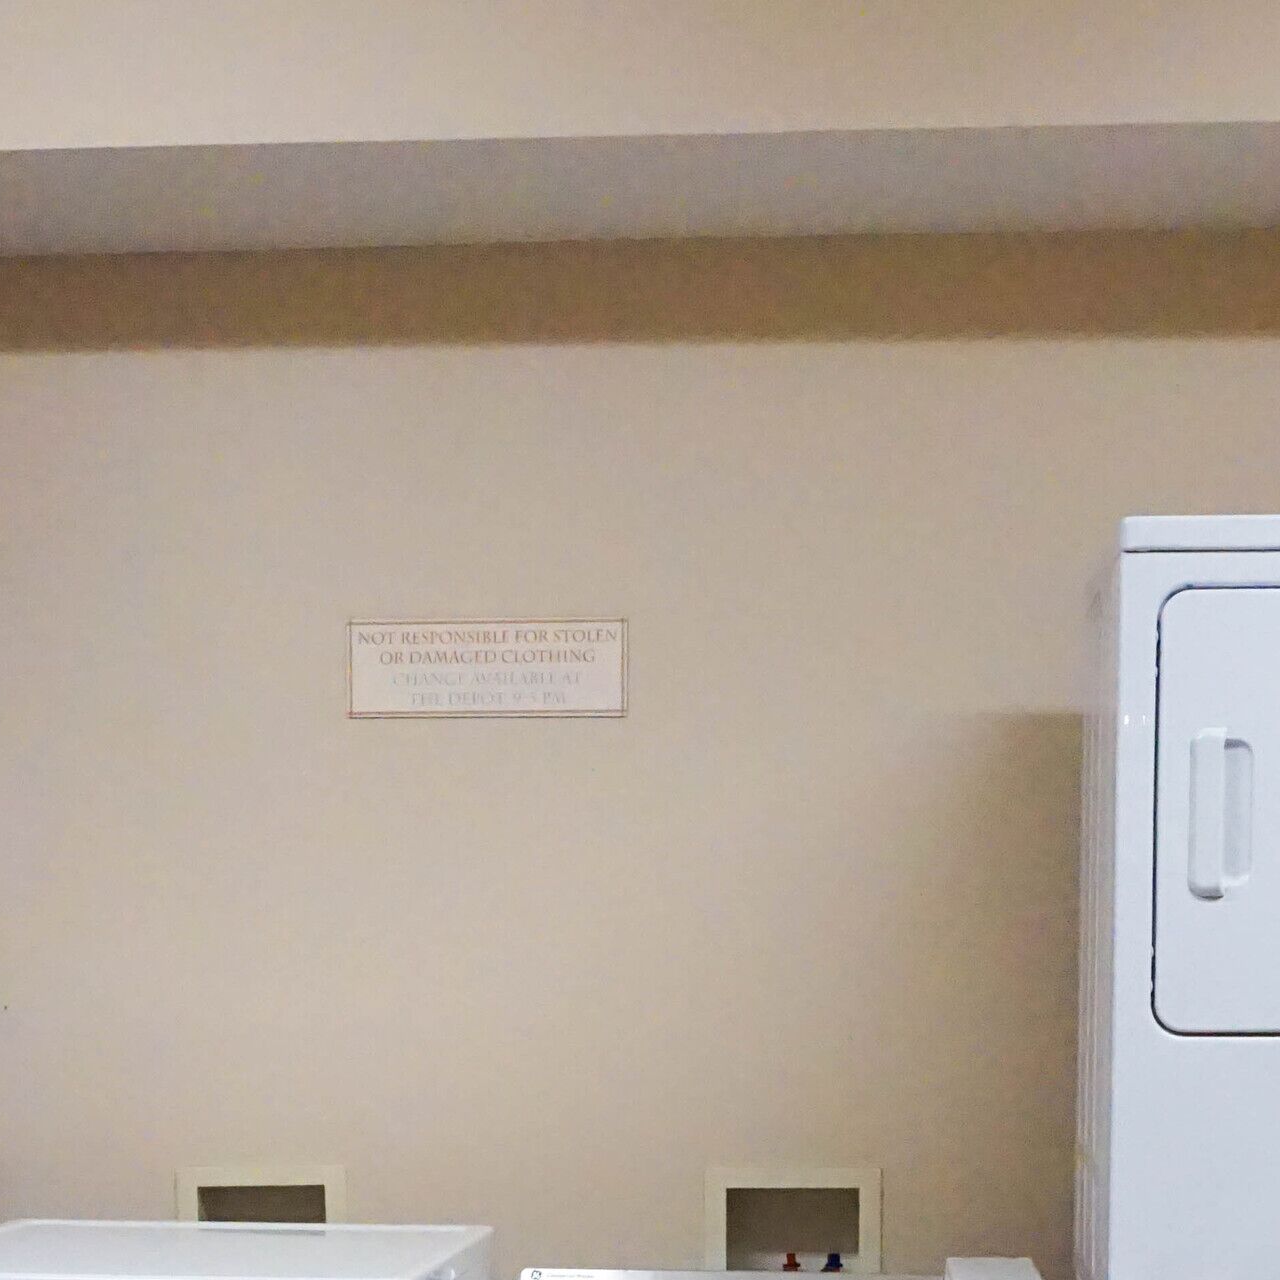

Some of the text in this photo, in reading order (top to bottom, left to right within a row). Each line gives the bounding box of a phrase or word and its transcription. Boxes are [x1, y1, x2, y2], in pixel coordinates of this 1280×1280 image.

[358, 628, 618, 646] NOT RESPONSIBLE FOR STOLEN
[379, 648, 596, 666] OR DAMAGED CLOTHING
[392, 671, 581, 687] CHANGE AVAILABLE AT
